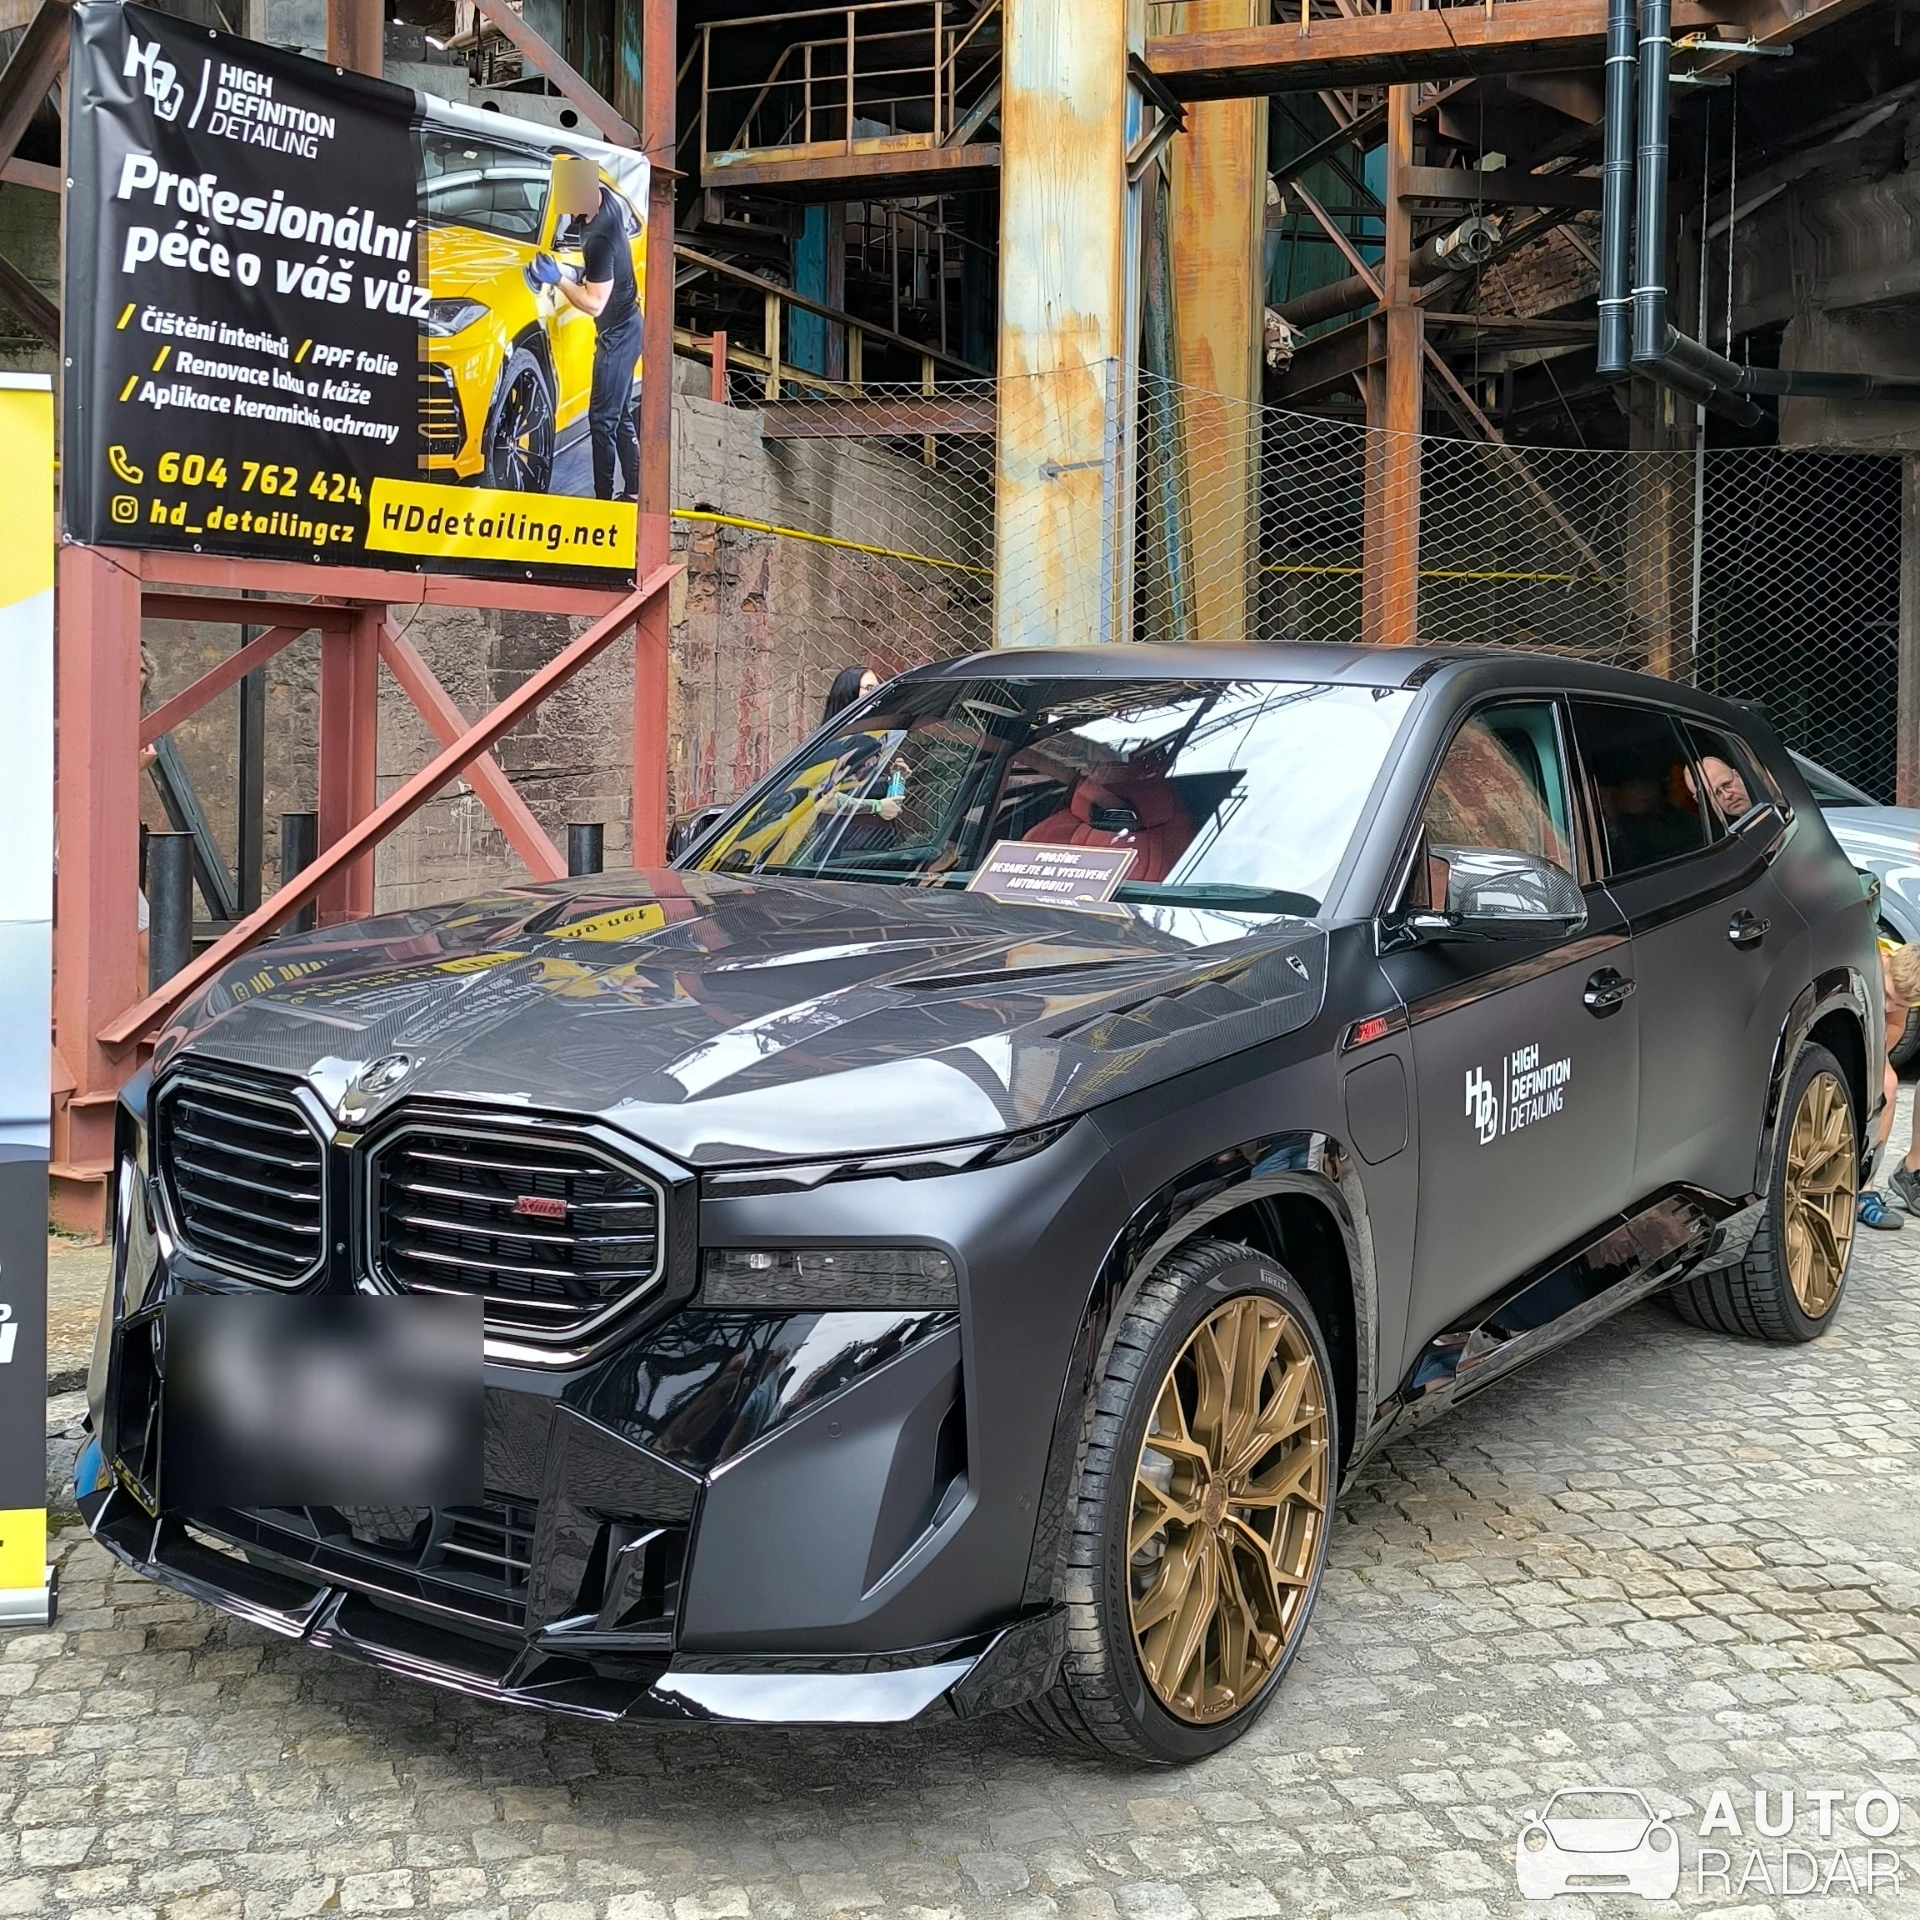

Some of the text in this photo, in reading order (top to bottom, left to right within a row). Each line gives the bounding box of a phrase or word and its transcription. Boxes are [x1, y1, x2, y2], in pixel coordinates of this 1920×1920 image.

[218, 63, 273, 98] HIGH
[207, 112, 319, 159] DETAILING
[214, 87, 336, 139] DEFINITION
[117, 153, 417, 262] Profesionální
[122, 220, 434, 319] péče o váš vůz
[140, 304, 289, 359] Čištění interiérů
[175, 351, 372, 405] Renovace laku a kůže
[311, 344, 399, 377] PPF folie
[138, 380, 400, 445] Aplikace keramické ochrany
[158, 451, 362, 505] 604 762 424
[150, 498, 355, 546] hd_detailingcz
[382, 502, 618, 551] HDdetailing.net
[988, 862, 1113, 881] NESAHEJTE NA VYSTAVENÉ
[1034, 851, 1082, 865] PROSÍME
[1006, 877, 1076, 893] AUTOMOBILY!
[1511, 1043, 1539, 1076] HIGH
[1511, 1057, 1571, 1104] DEFINITION
[1510, 1087, 1564, 1132] DETAILING
[1260, 1268, 1288, 1293] PIRELLI
